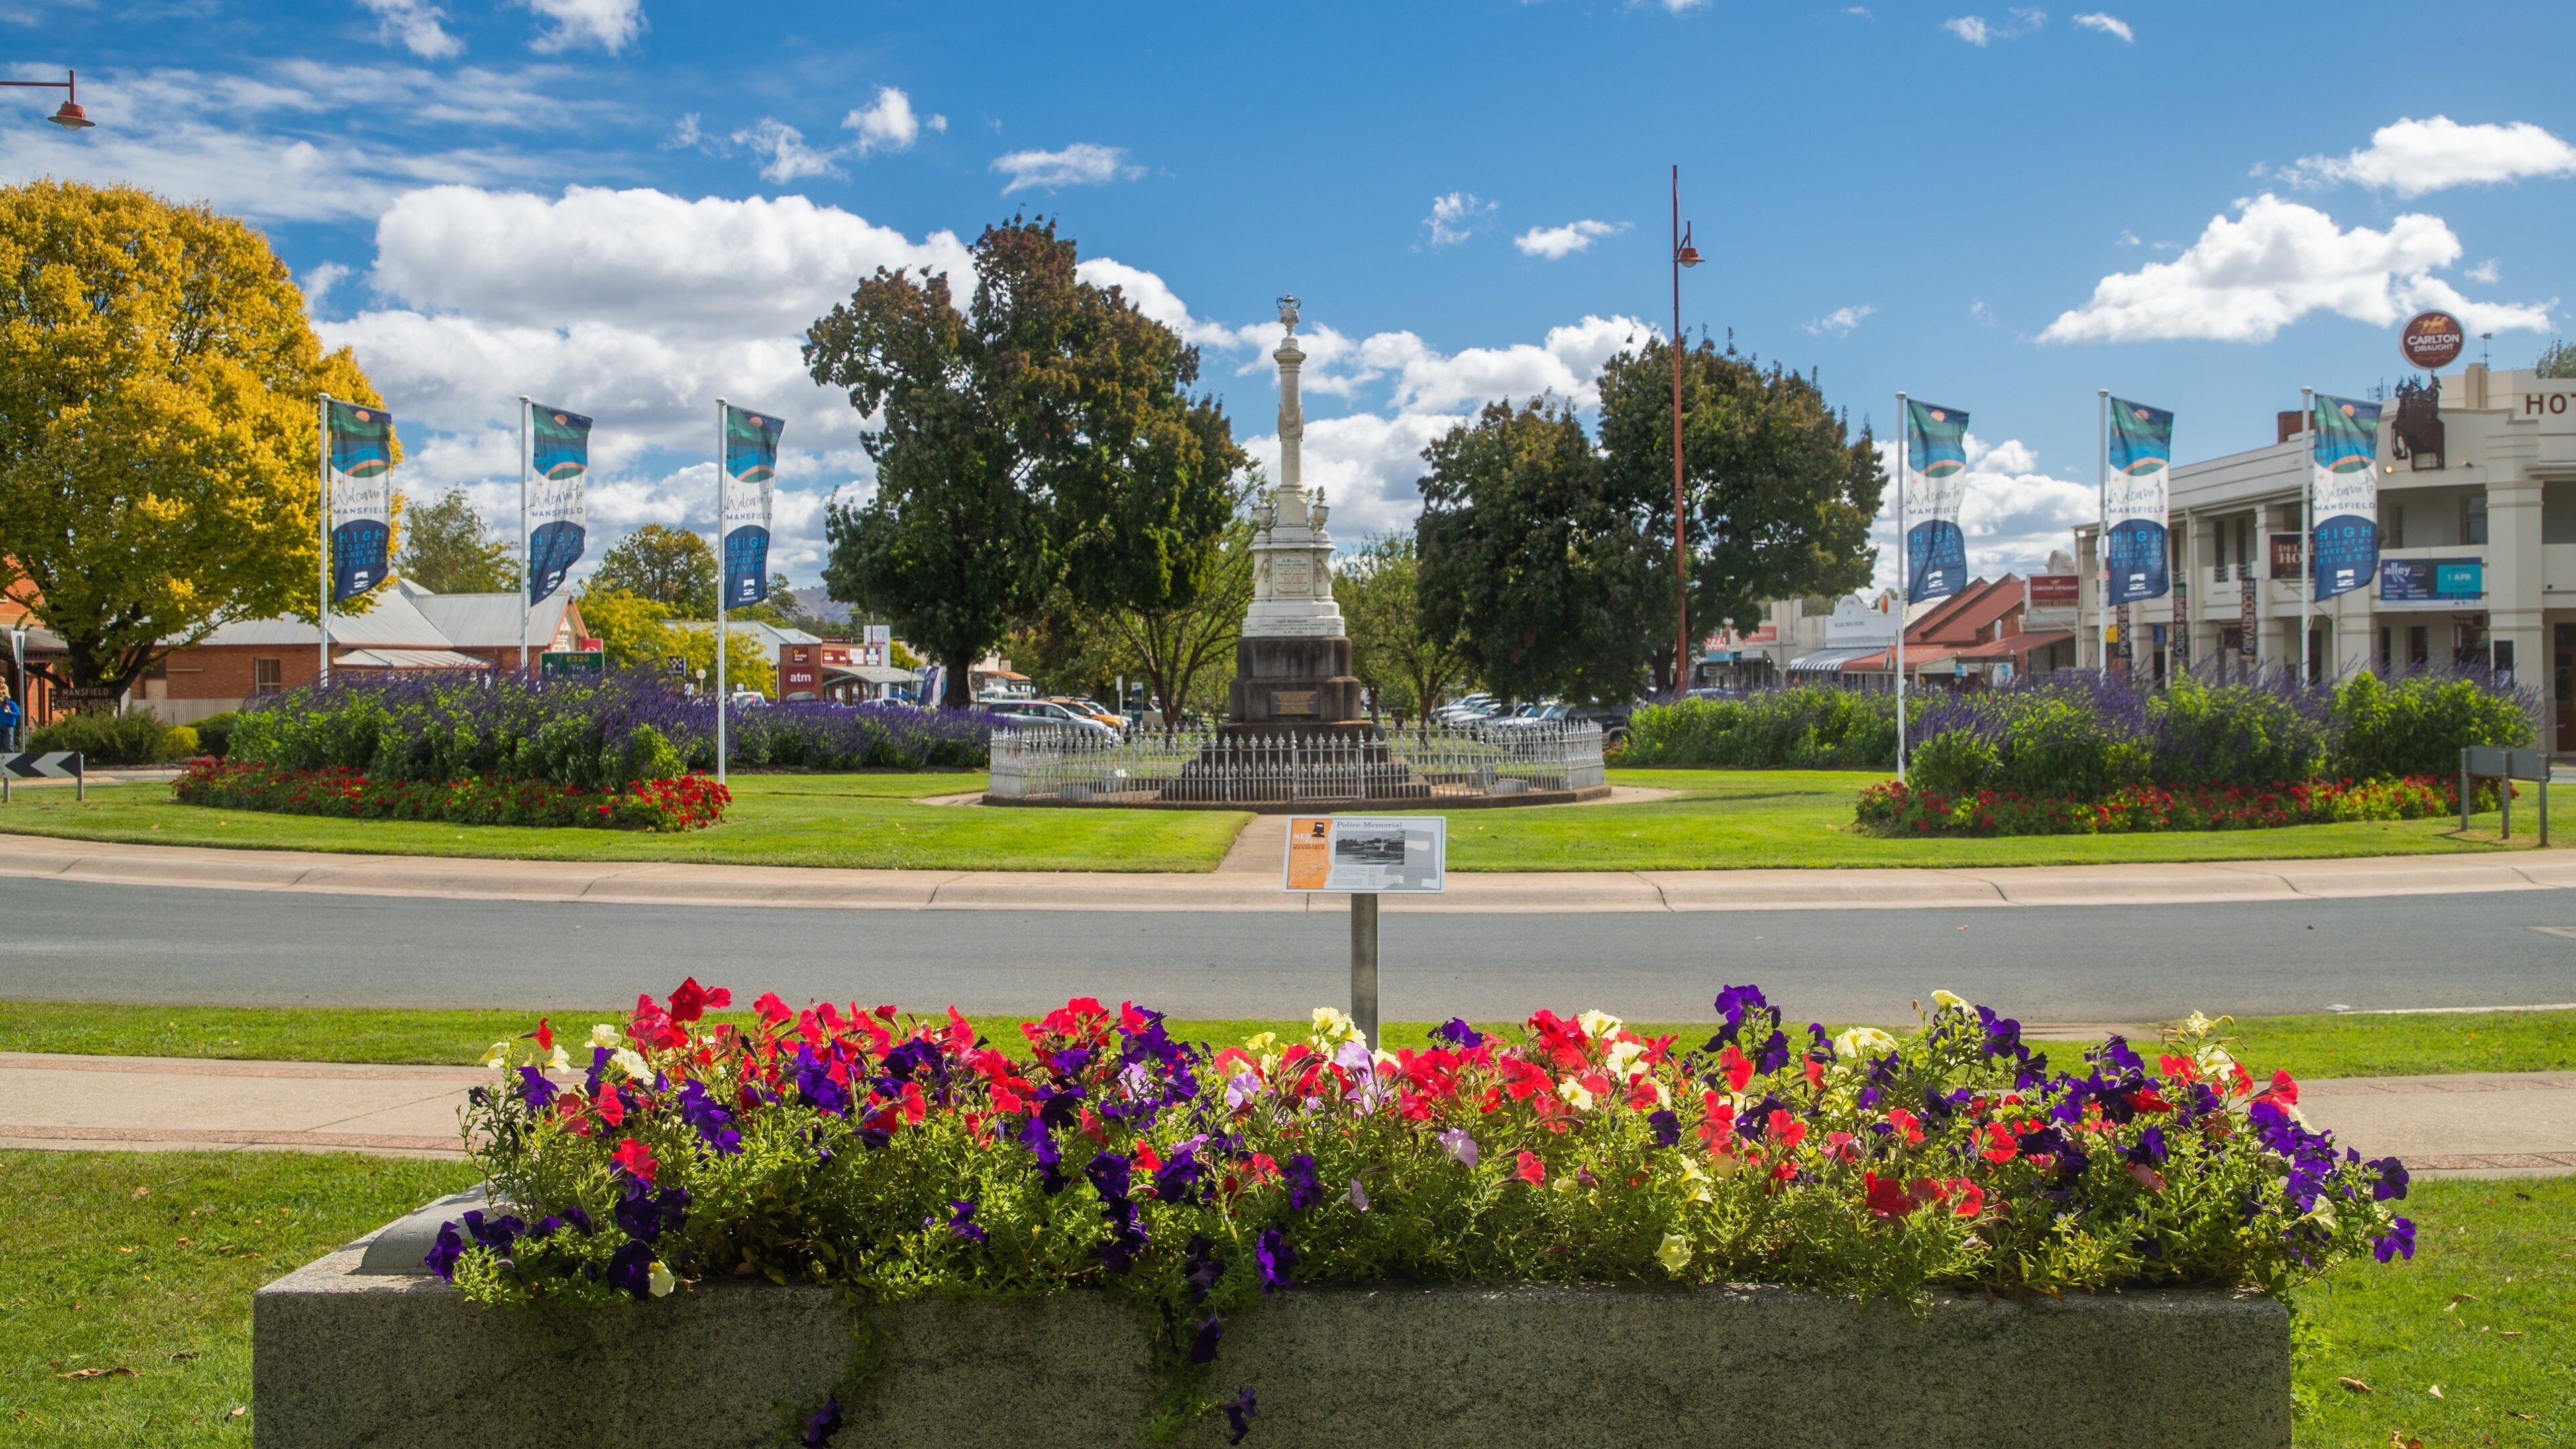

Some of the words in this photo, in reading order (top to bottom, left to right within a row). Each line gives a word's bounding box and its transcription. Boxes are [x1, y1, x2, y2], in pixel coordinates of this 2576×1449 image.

[2407, 334, 2459, 345] CARLTON
[2414, 343, 2454, 352] DRAUGHT
[331, 487, 380, 506] Welcome
[380, 482, 388, 498] to
[531, 490, 574, 508] Welcome
[573, 484, 583, 500] to
[1907, 486, 1951, 506] Welcome
[1951, 482, 1960, 499] to
[2108, 486, 2155, 504] Welcome
[2154, 480, 2164, 498] to
[2314, 482, 2363, 502] Welcome
[2361, 476, 2375, 494] to
[725, 492, 763, 511] Welcome
[763, 488, 773, 503] to
[2314, 502, 2376, 511] MANSFIELD
[333, 506, 389, 515] MANSFIELD
[532, 507, 583, 517] MANSFIELD
[726, 513, 773, 521] MANSFIELD
[339, 529, 385, 543] HIGH
[535, 531, 579, 546] HIGH
[1913, 529, 1955, 544] HIGH
[2113, 530, 2162, 543] HIGH
[2318, 525, 2372, 541] HIGH
[730, 537, 766, 549] HIGH
[339, 556, 386, 568] RIVERS
[2384, 562, 2411, 578] alley
[2175, 597, 2186, 614] BAR
[2243, 593, 2255, 653] COURTYARD
[2175, 624, 2186, 655] BISTRO
[790, 673, 812, 682] atm
[973, 677, 983, 686] 50
[62, 688, 109, 696] MANSFIELD
[56, 699, 82, 708] COURT
